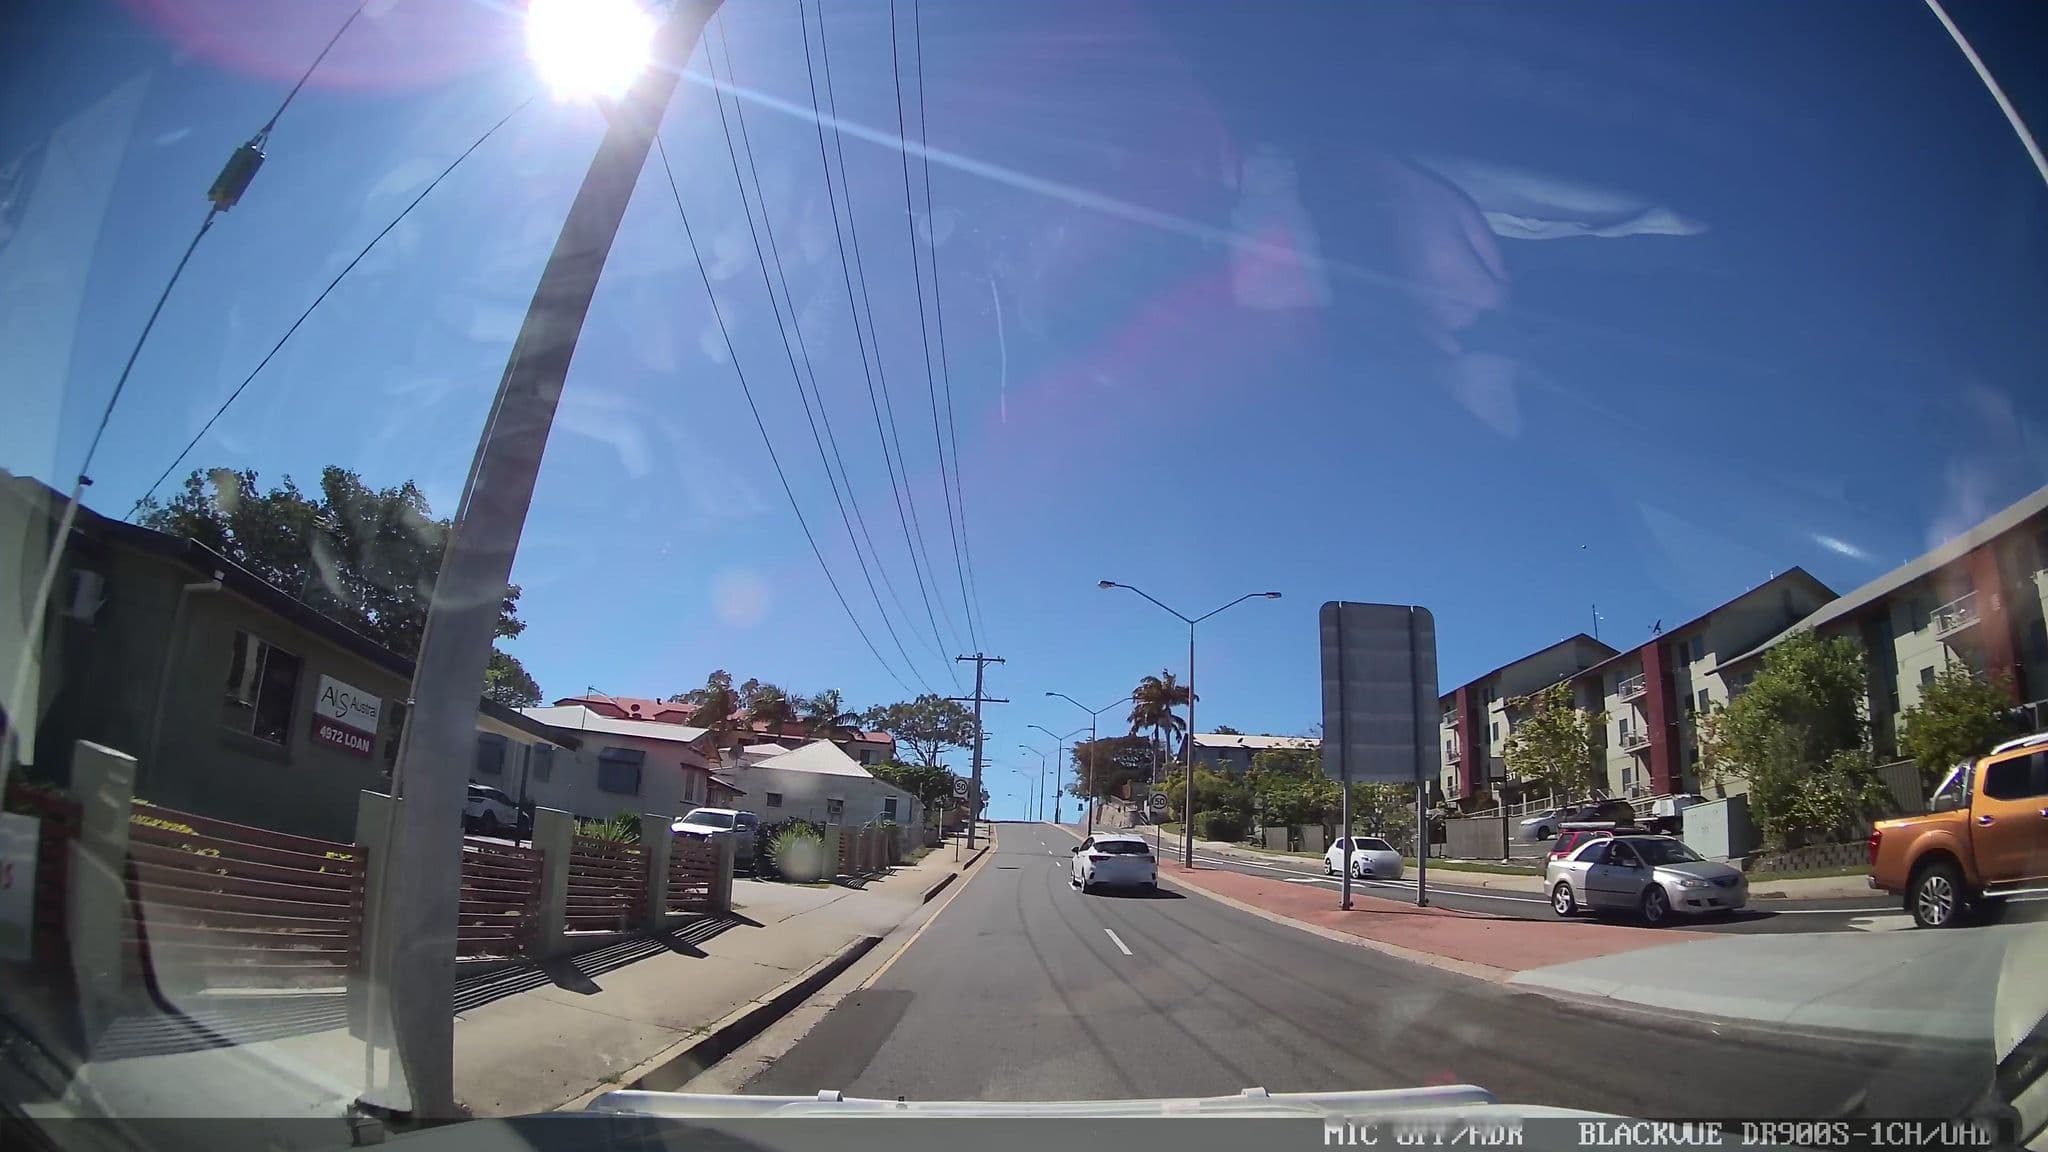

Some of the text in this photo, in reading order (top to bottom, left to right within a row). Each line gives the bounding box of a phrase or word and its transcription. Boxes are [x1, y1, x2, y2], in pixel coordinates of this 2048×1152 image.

[320, 726, 370, 752] 4972 LOAN
[1154, 797, 1165, 806] 50
